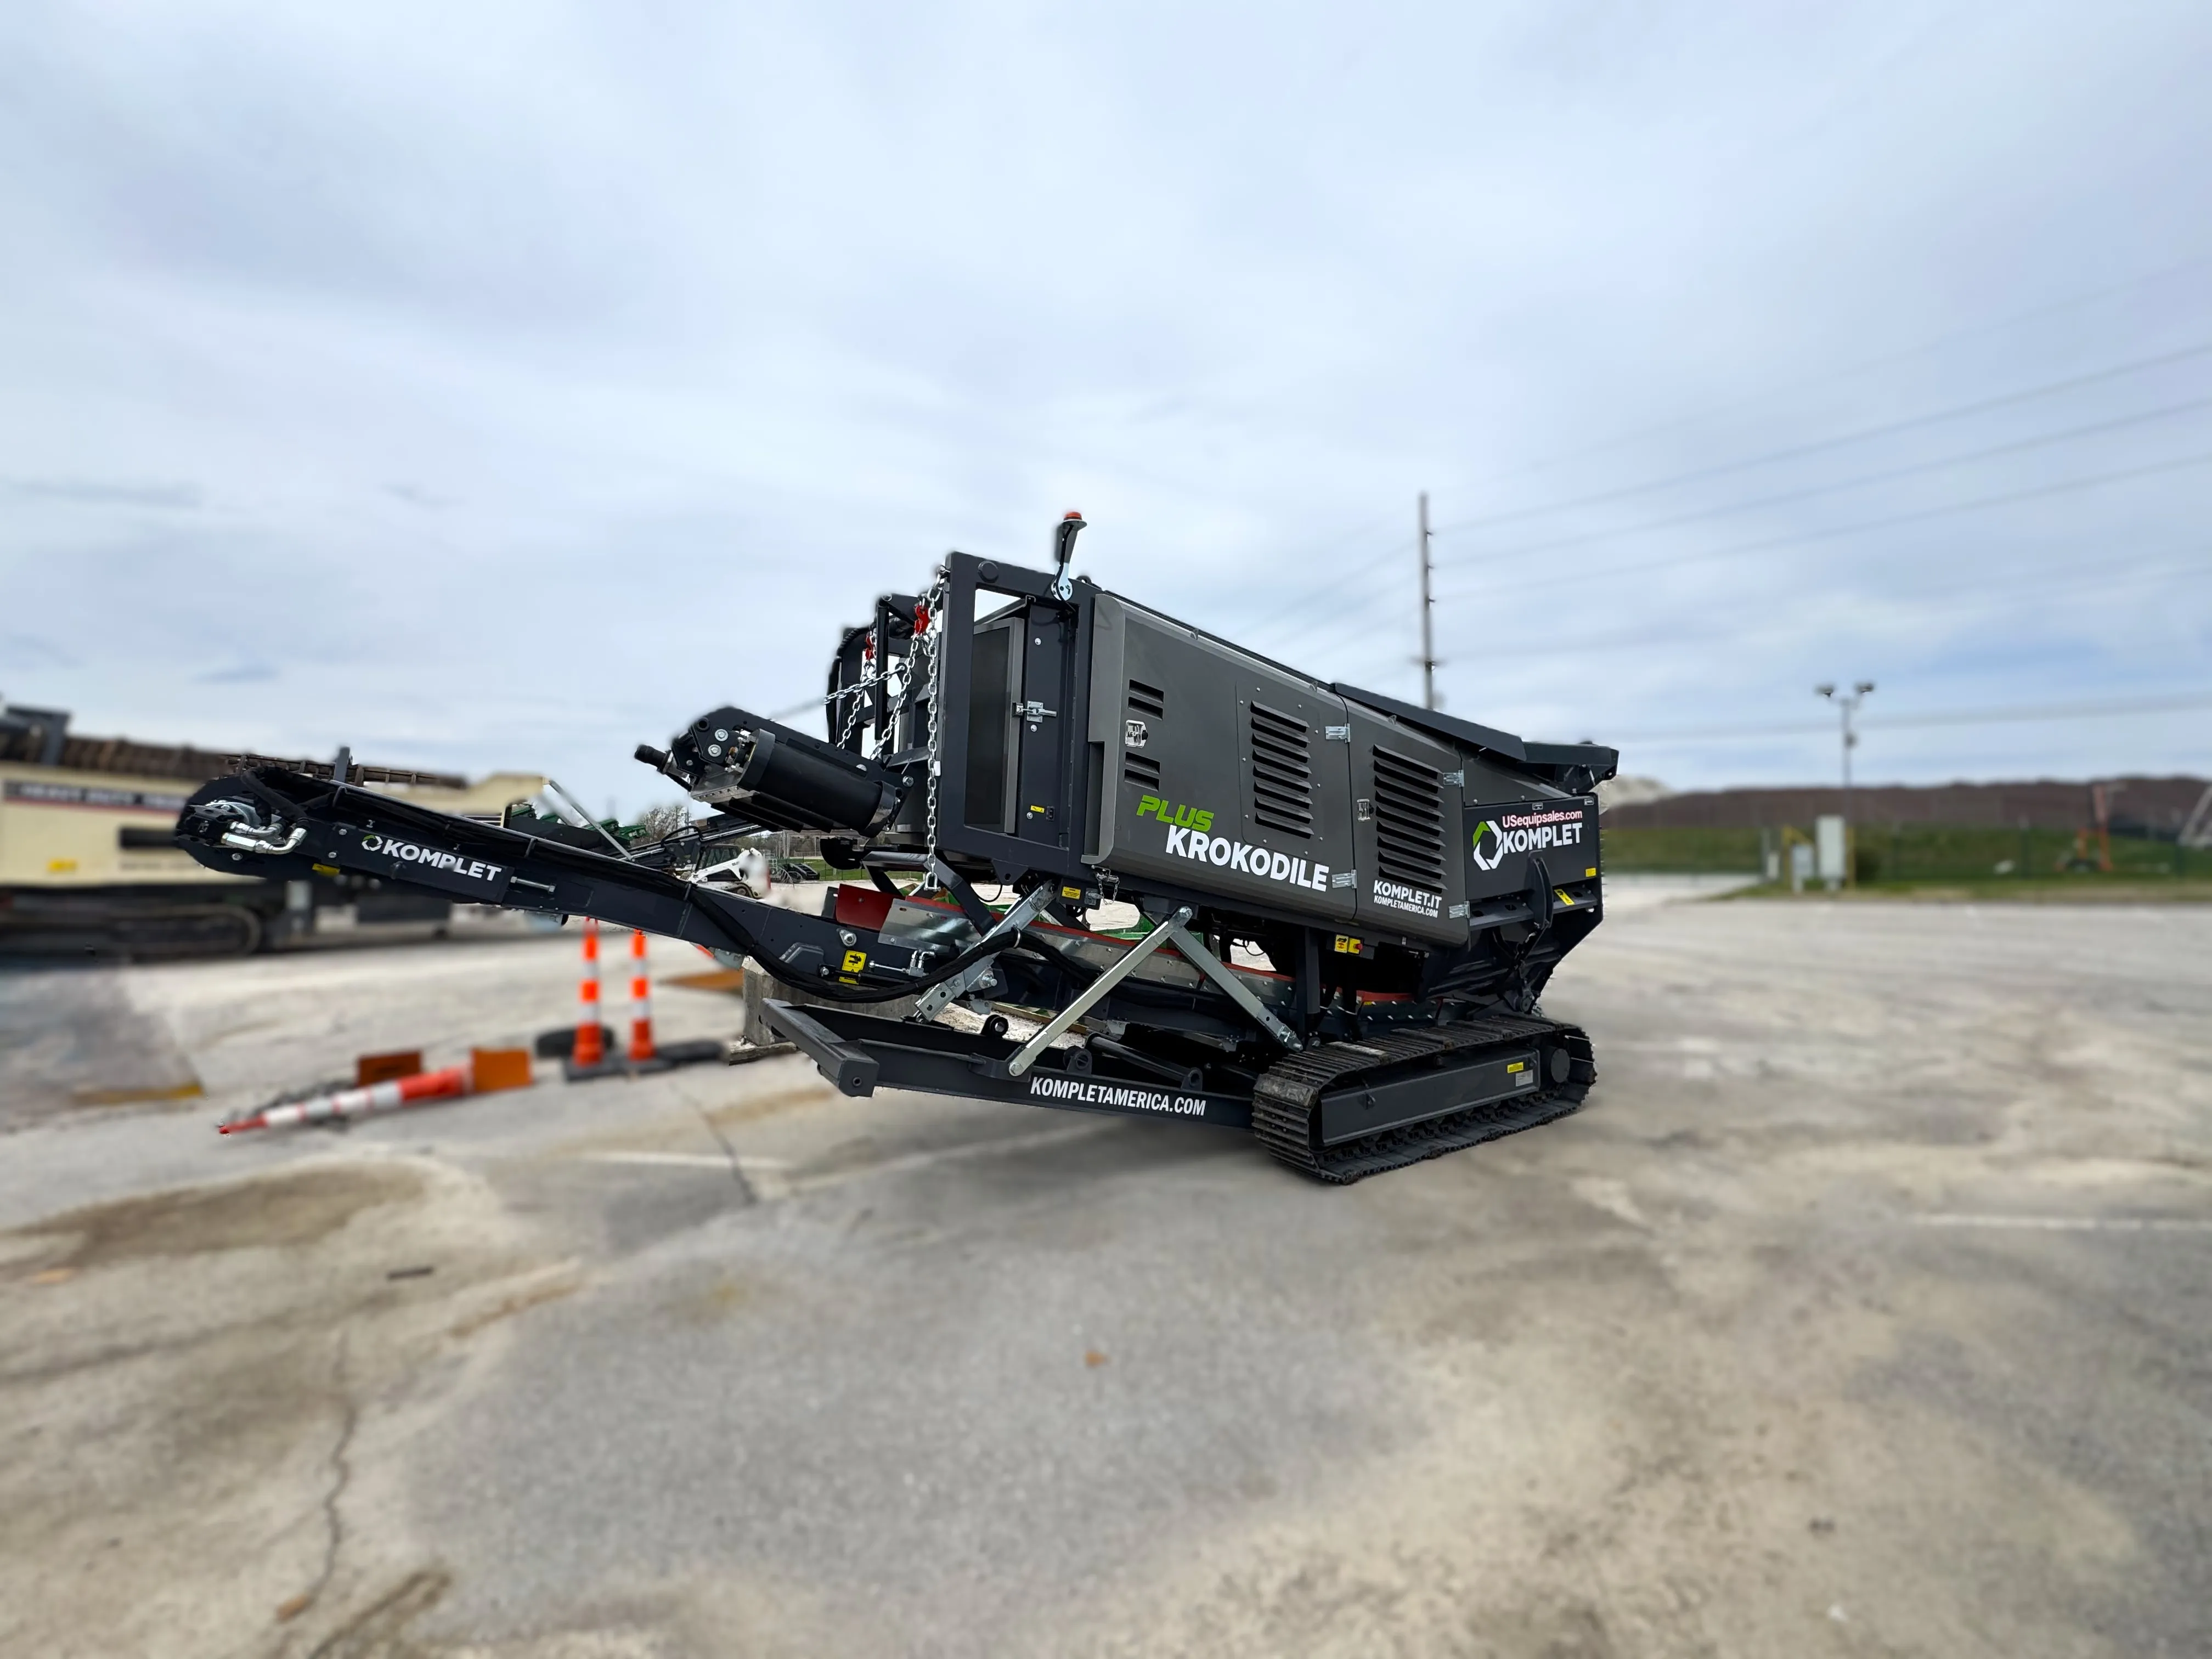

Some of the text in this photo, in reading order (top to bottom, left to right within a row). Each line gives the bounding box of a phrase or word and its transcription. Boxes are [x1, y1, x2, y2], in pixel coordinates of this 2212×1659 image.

[1136, 794, 1214, 832] PLUS
[1502, 810, 1582, 828] USequipsales.com
[1503, 822, 1582, 854] KOMPLET
[382, 839, 501, 881] KOMPLET
[1166, 825, 1329, 891] KROKODILE
[1373, 880, 1442, 909] KOMPLET.IT
[1374, 895, 1438, 918] KOMPLETAMERICA.COM
[1030, 1077, 1206, 1116] KOMPLETAMERICA.COM
